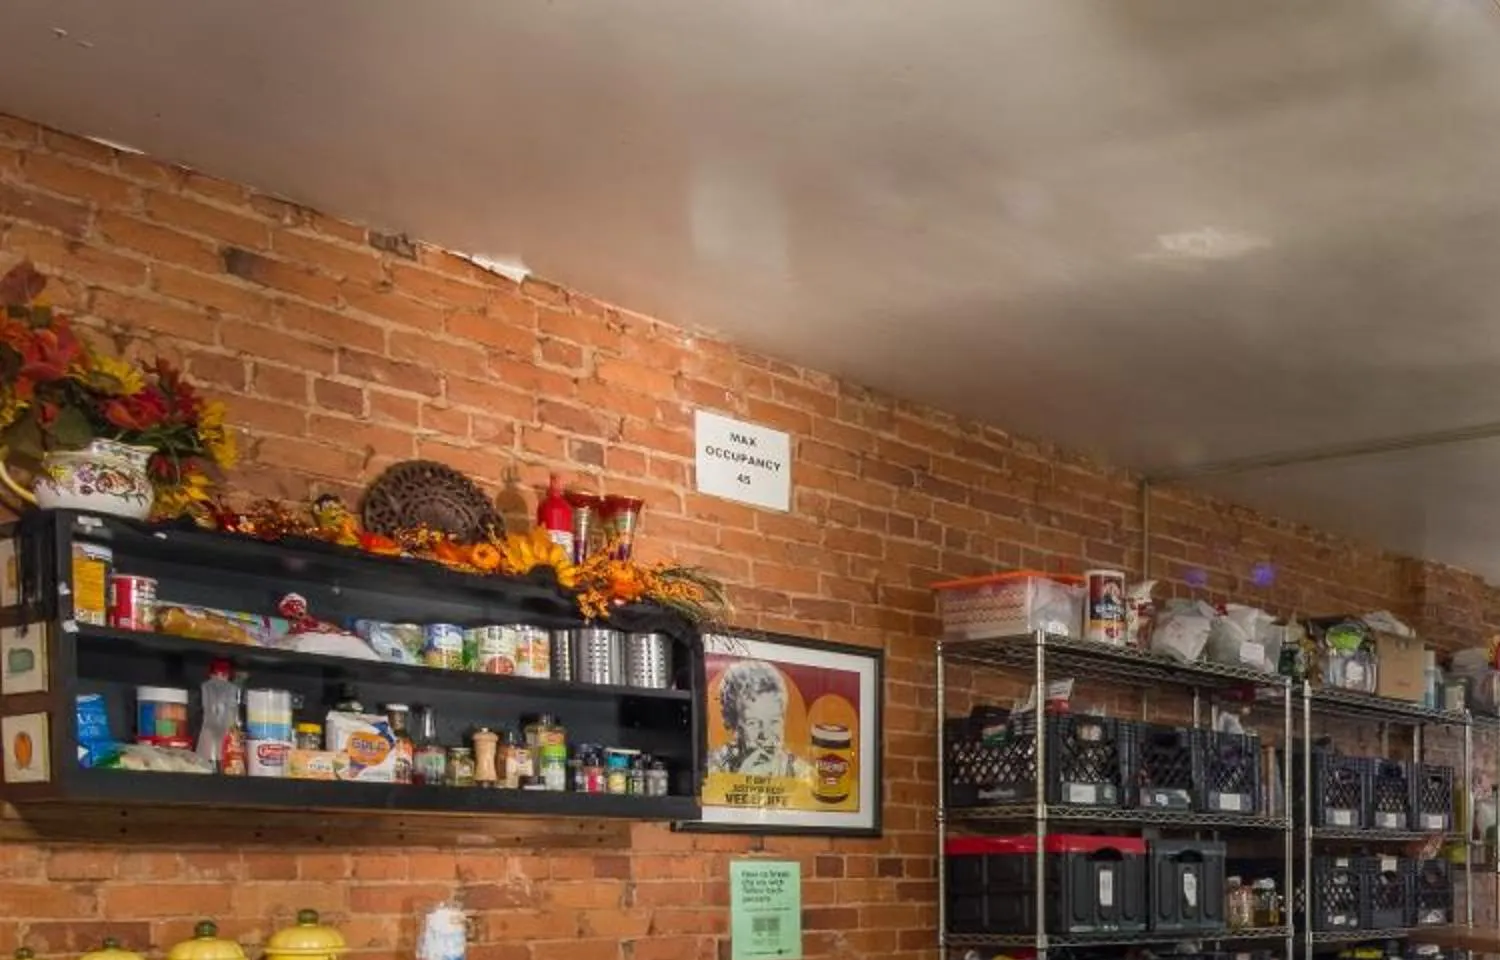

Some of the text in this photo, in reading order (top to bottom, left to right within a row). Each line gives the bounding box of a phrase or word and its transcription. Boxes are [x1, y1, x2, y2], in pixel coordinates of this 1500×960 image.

[729, 432, 758, 447] MAX
[705, 445, 781, 471] OCCUPANCY
[736, 473, 752, 486] 45
